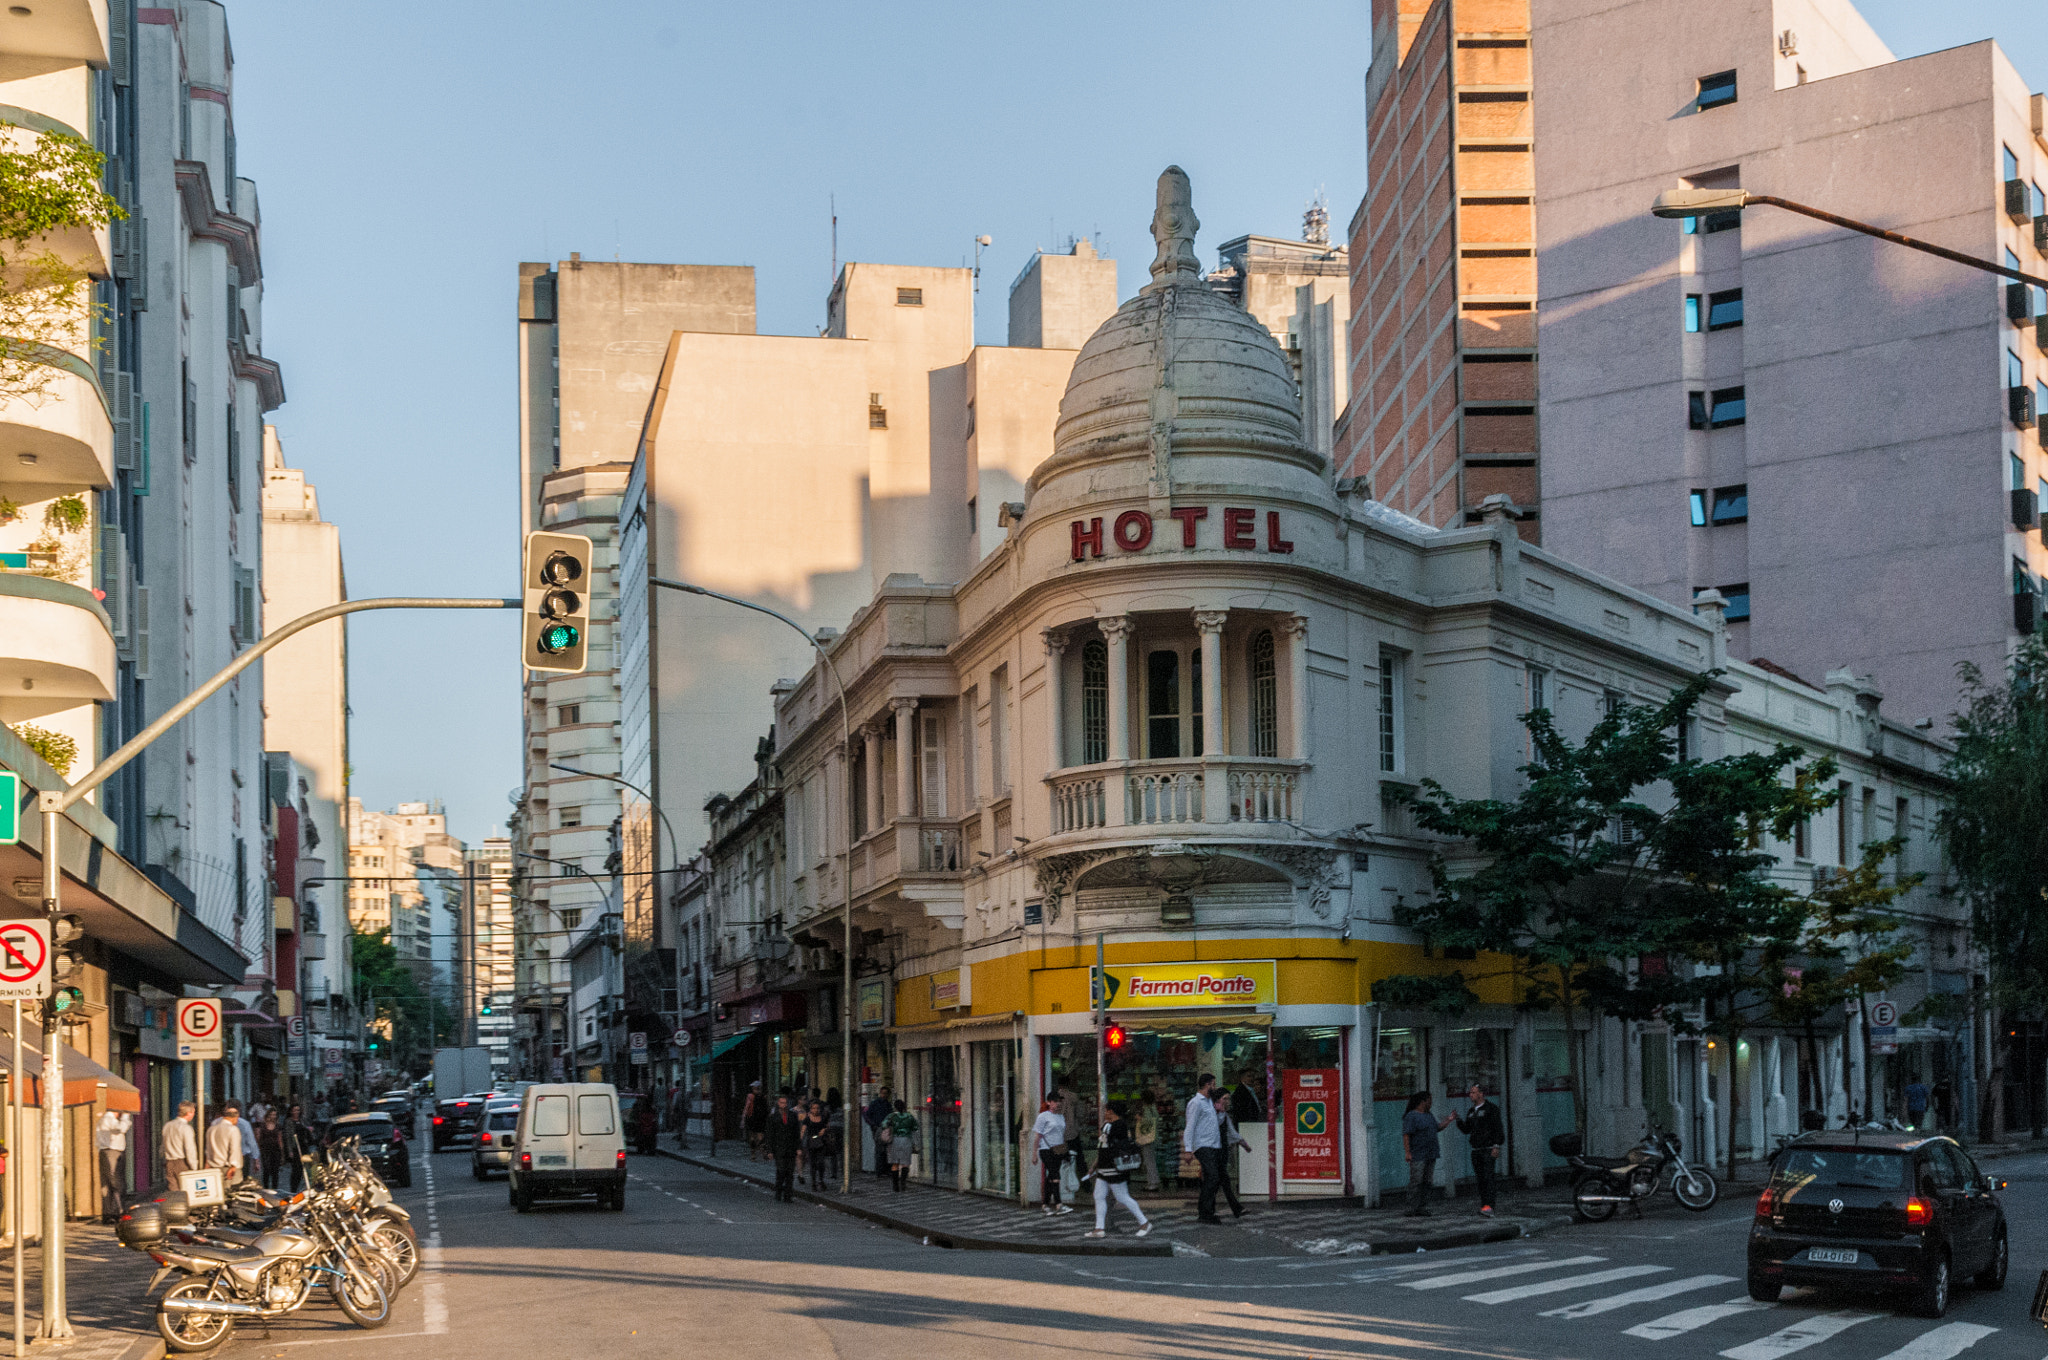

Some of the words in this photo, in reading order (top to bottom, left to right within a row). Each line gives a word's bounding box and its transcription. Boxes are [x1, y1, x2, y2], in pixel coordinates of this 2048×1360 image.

[1071, 506, 1294, 561] HOTEL
[1129, 977, 1194, 996] Farma
[1197, 975, 1255, 995] Ponte
[192, 1009, 206, 1029] E
[1879, 1007, 1889, 1021] E
[1292, 1090, 1310, 1100] AQUI
[1311, 1090, 1329, 1099] TEM
[1292, 1136, 1332, 1147] FARMÁCIA
[1293, 1147, 1331, 1157] POPULAR
